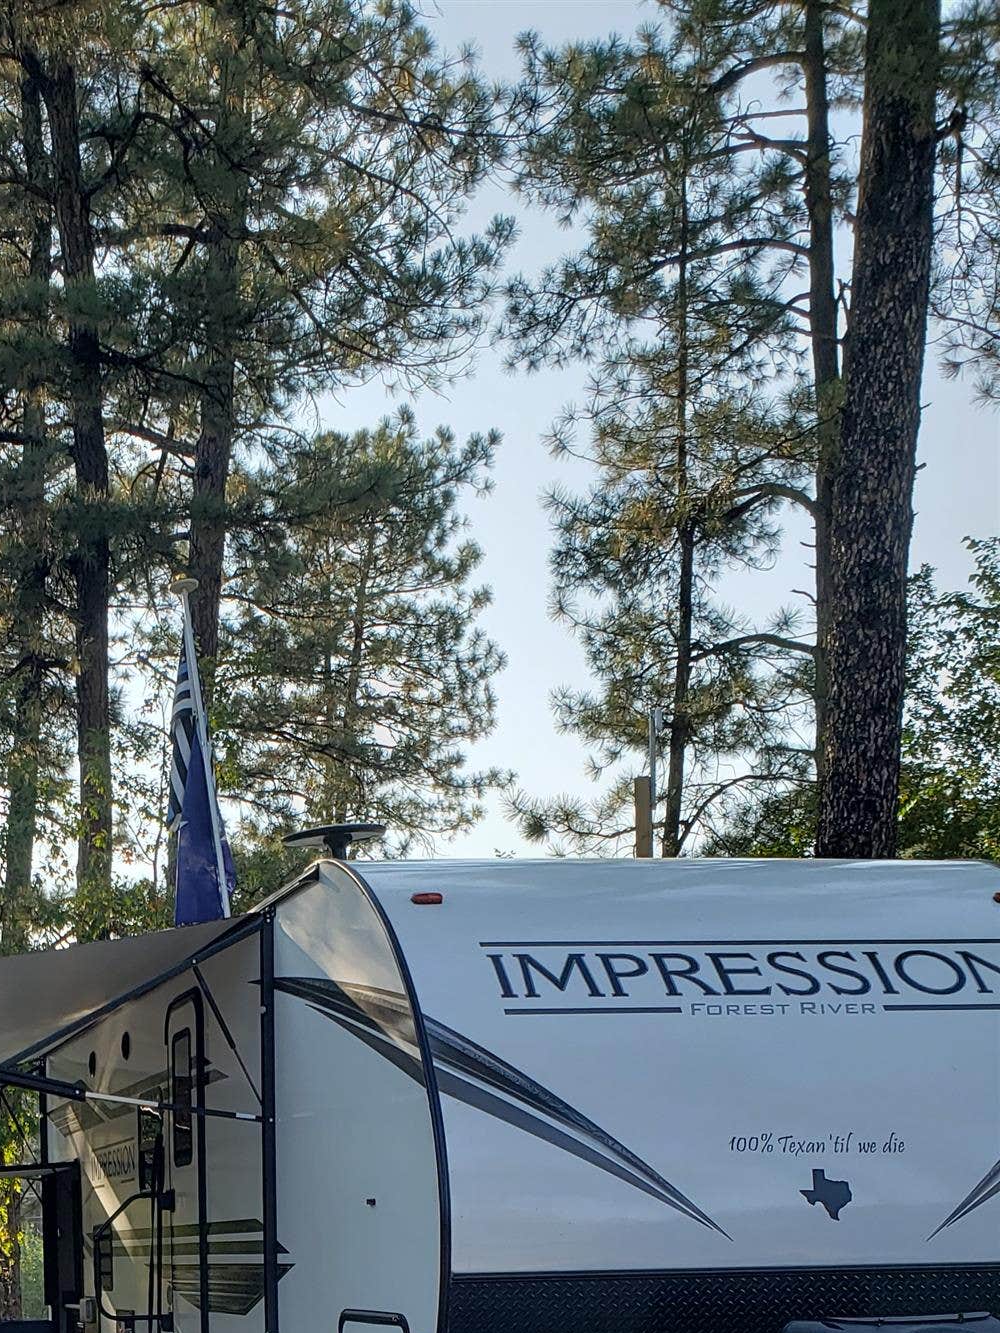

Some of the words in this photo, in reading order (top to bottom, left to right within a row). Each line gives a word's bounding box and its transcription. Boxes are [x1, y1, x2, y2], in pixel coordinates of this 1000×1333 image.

[486, 950, 1000, 998] IMPRESSION
[690, 1002, 790, 1016] FOREST
[801, 1002, 876, 1015] RIVER
[729, 1133, 774, 1153] 100%
[777, 1135, 826, 1156] Texan
[858, 1140, 877, 1153] we
[882, 1132, 905, 1153] die
